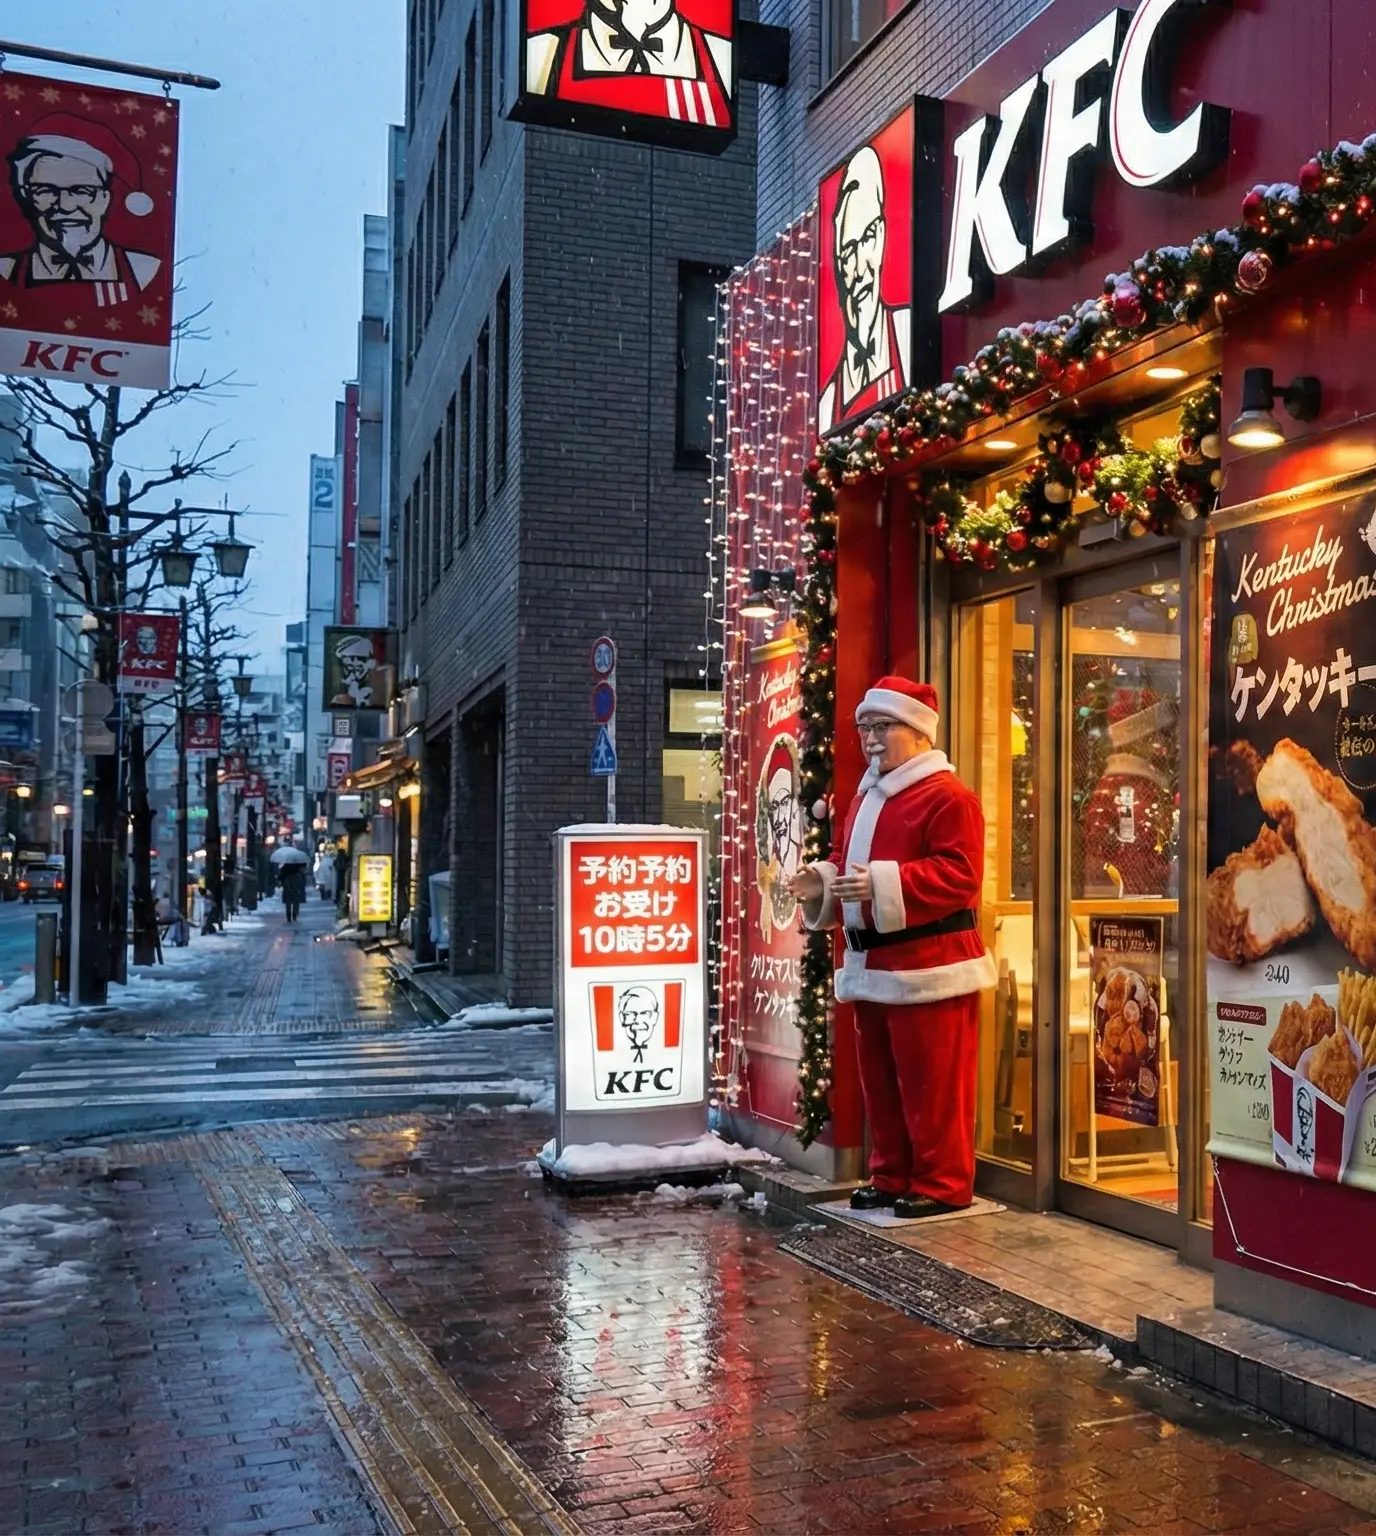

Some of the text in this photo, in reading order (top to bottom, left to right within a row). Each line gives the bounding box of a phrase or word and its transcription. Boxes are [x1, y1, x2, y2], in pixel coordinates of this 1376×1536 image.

[938, 0, 1204, 313] KFC
[20, 340, 125, 378] KFC
[1231, 525, 1344, 603] Kentucky
[578, 856, 692, 885] 予約予約
[595, 889, 677, 919] お受け
[579, 923, 692, 954] 10時5分
[604, 1067, 674, 1094] KFC
